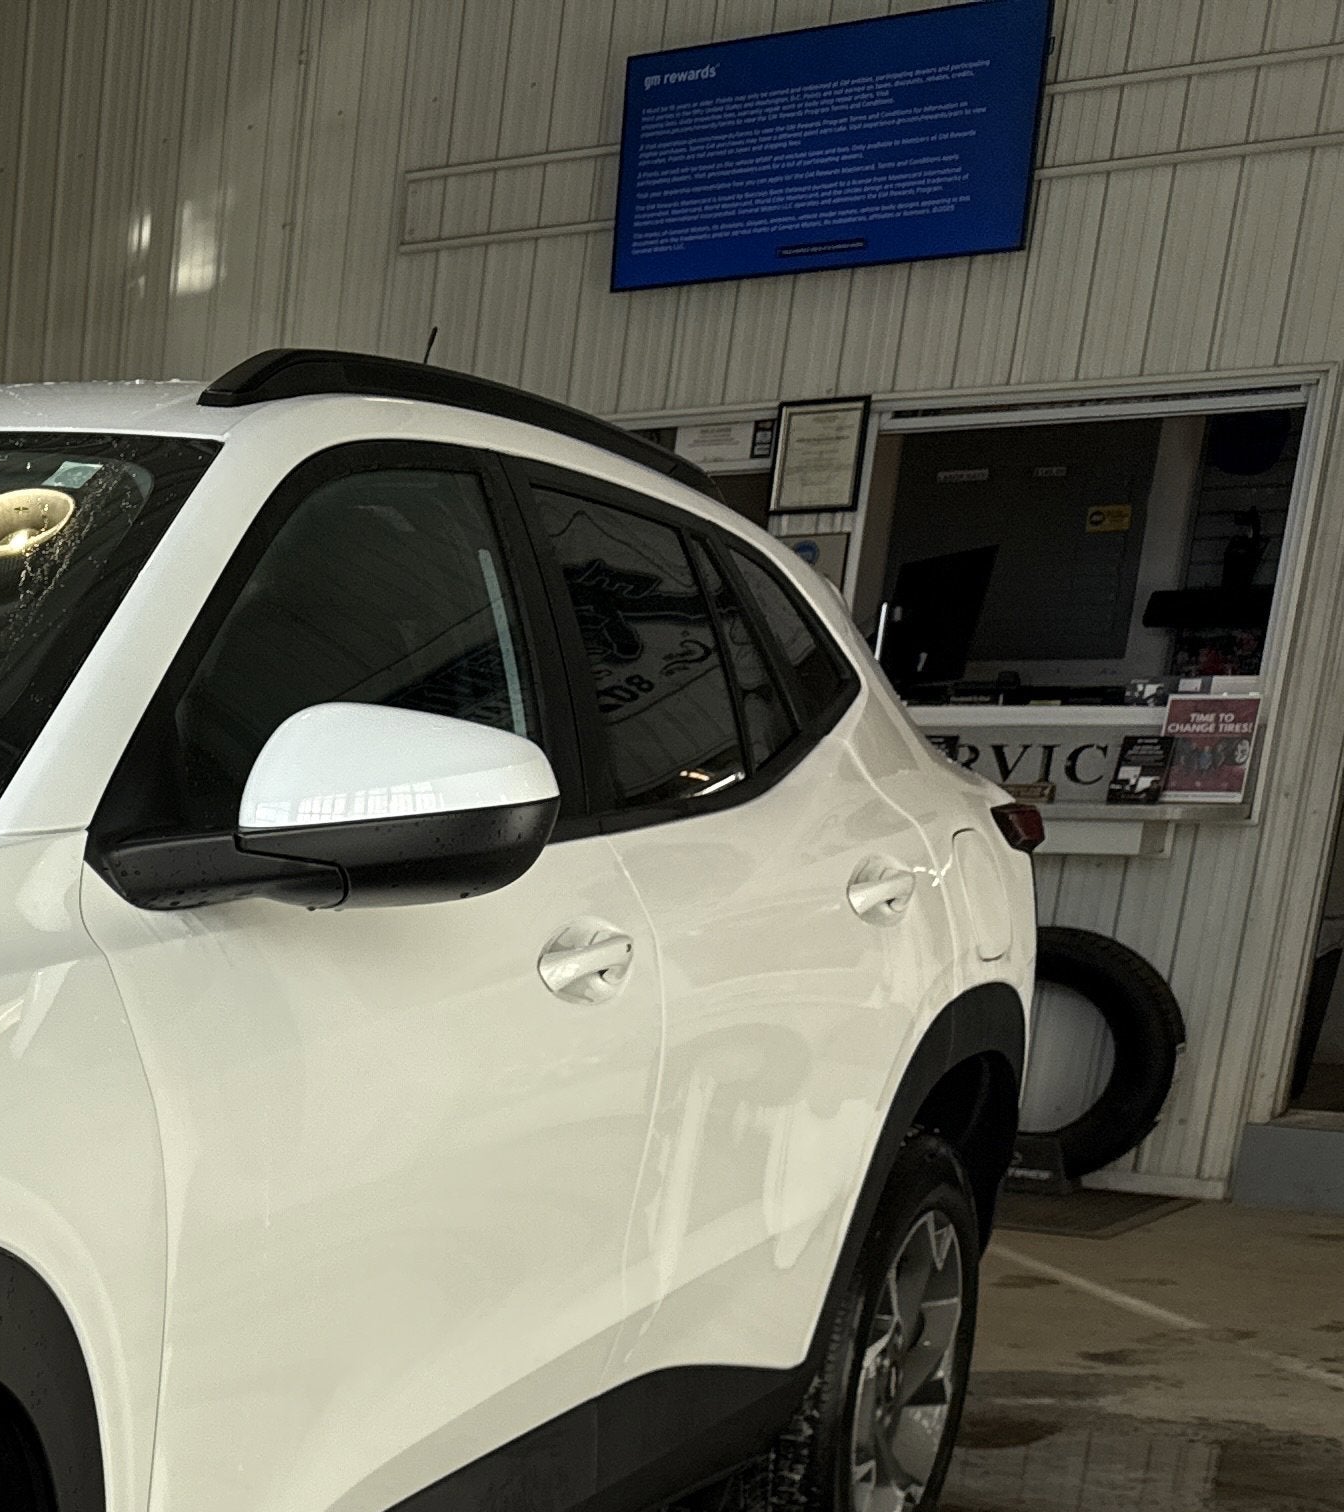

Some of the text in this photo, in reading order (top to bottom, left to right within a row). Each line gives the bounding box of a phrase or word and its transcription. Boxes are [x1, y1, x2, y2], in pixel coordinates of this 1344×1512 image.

[644, 65, 717, 91] gm rewards
[1190, 713, 1235, 723] TIME TO
[1167, 722, 1253, 733] CHANGE TIRES!
